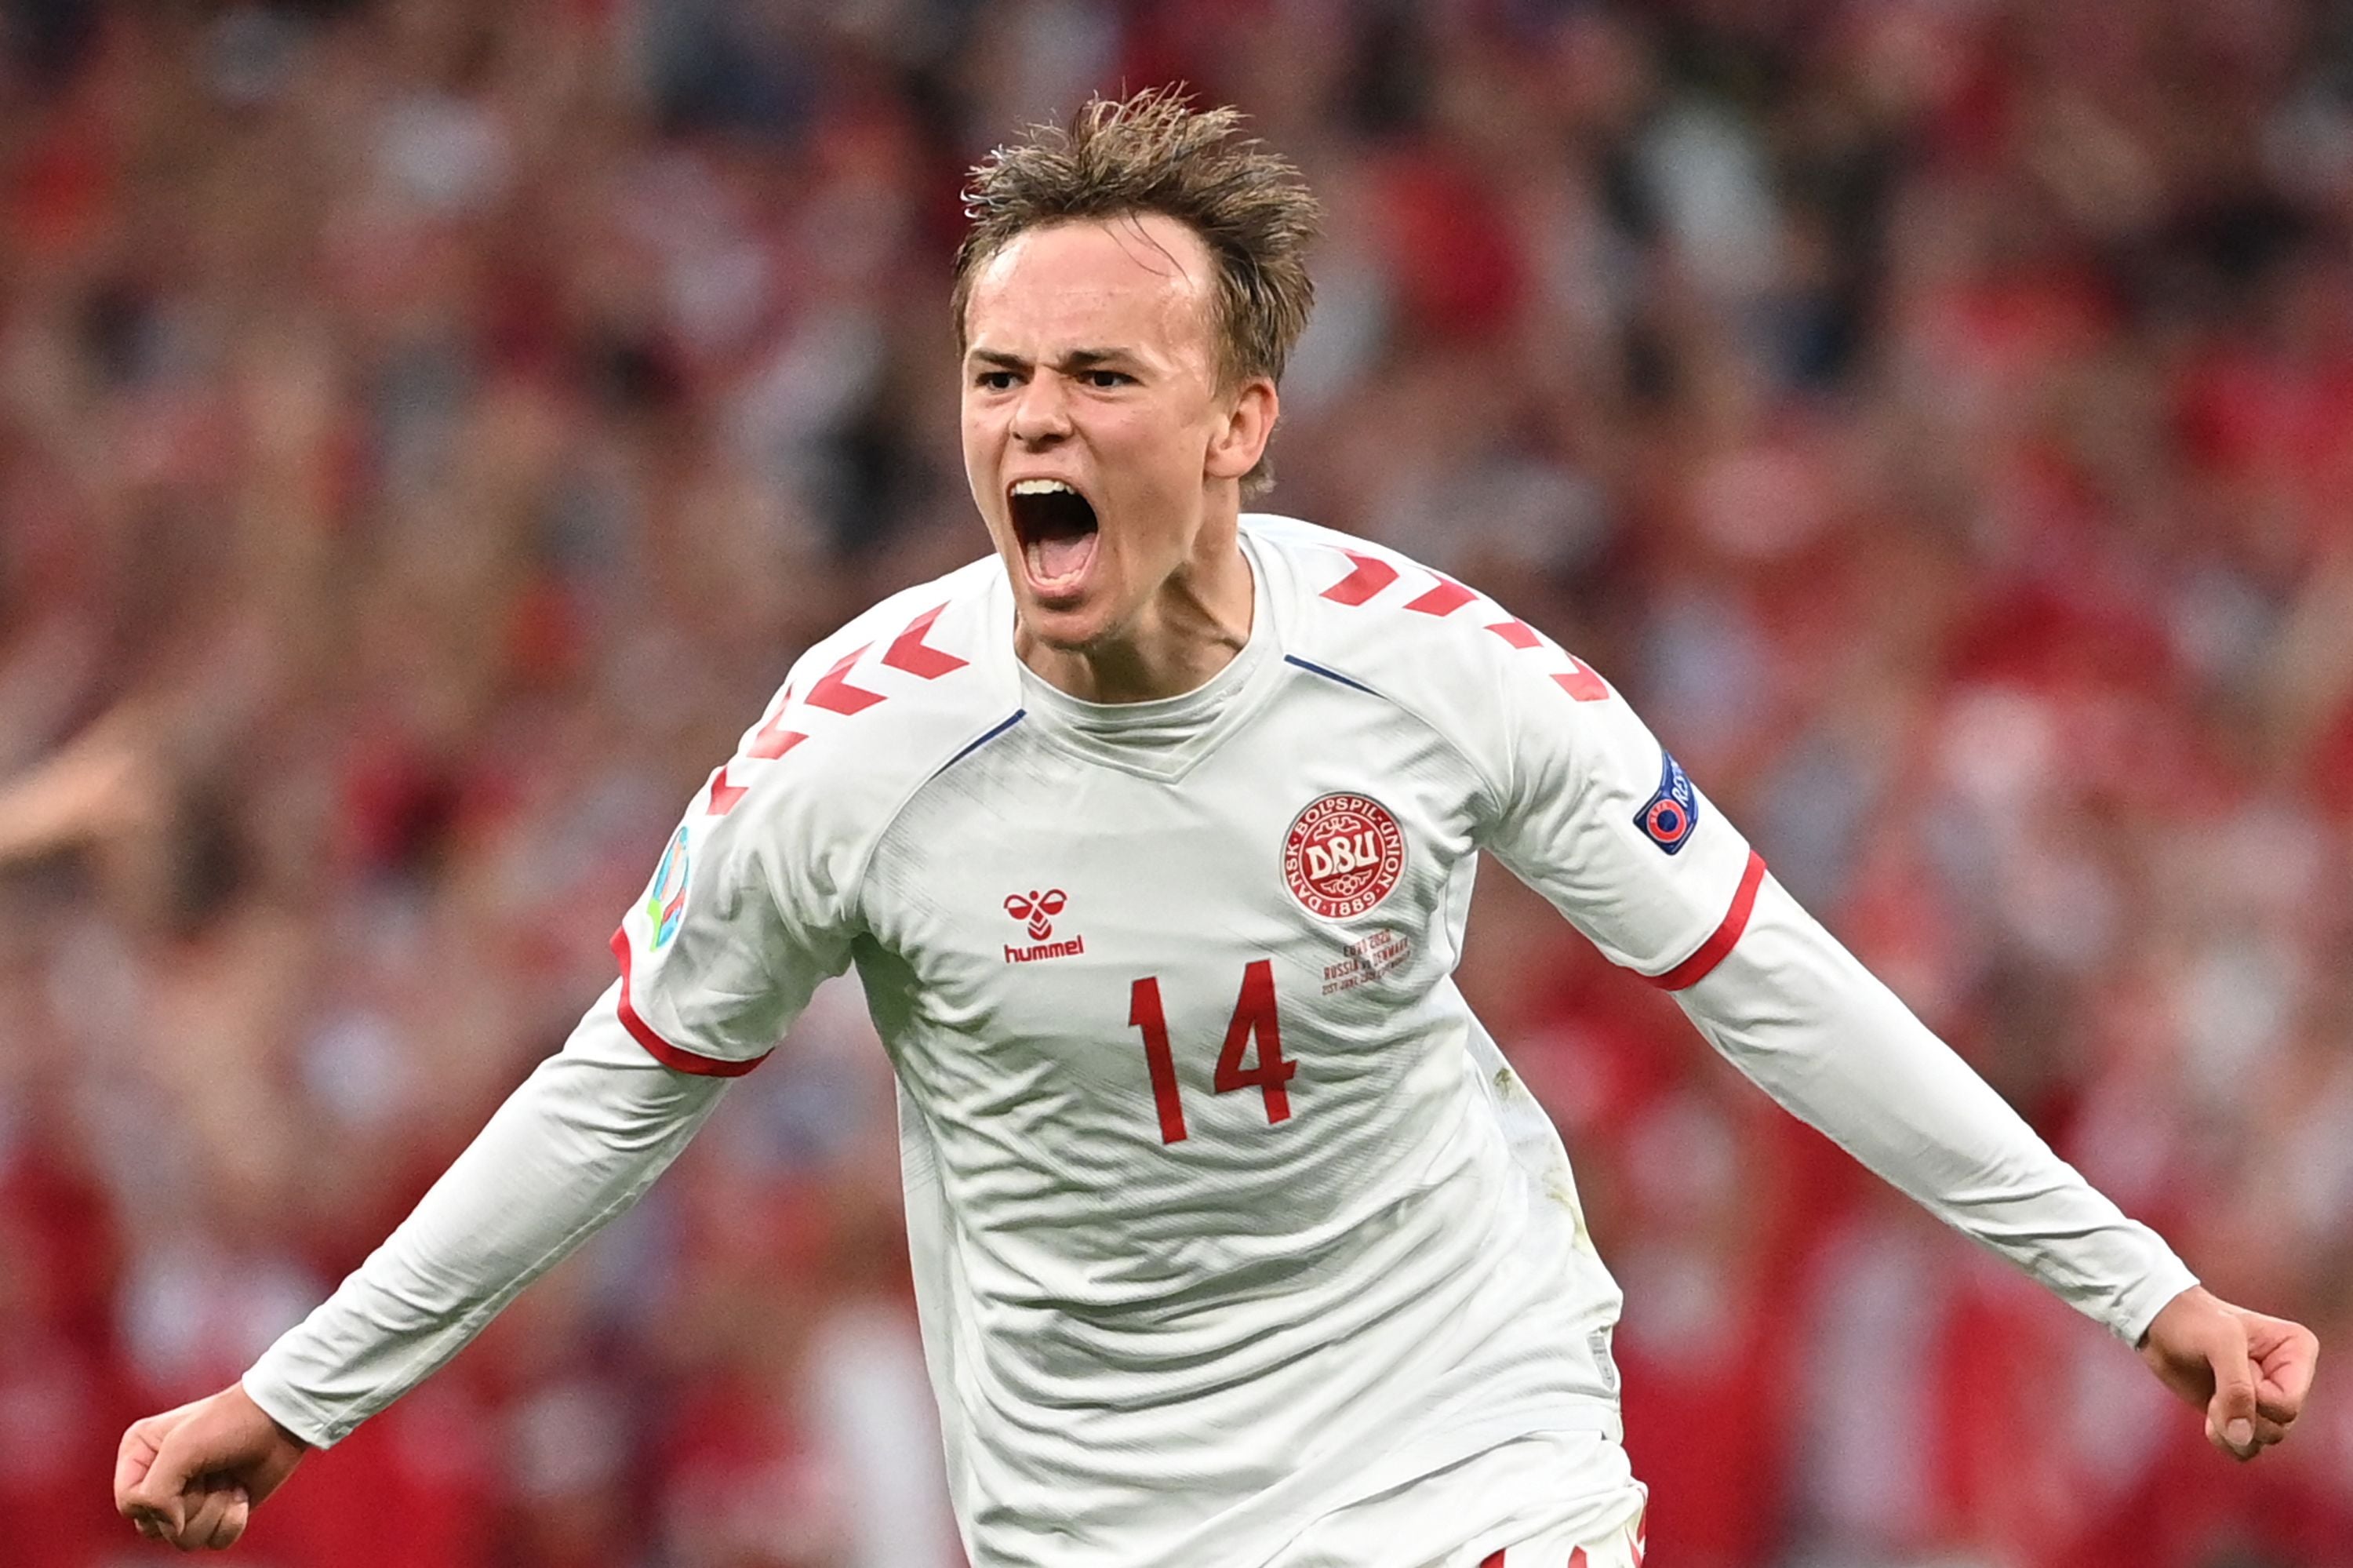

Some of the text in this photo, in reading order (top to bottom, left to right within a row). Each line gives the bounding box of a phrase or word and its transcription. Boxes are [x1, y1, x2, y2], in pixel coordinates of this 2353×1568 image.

[1286, 844, 1322, 911] DANSK
[1330, 891, 1376, 916] 1889
[1305, 831, 1379, 880] DBU
[1004, 934, 1084, 963] hummel
[1323, 959, 1358, 980] RUSSIA
[1128, 959, 1297, 1145] 14
